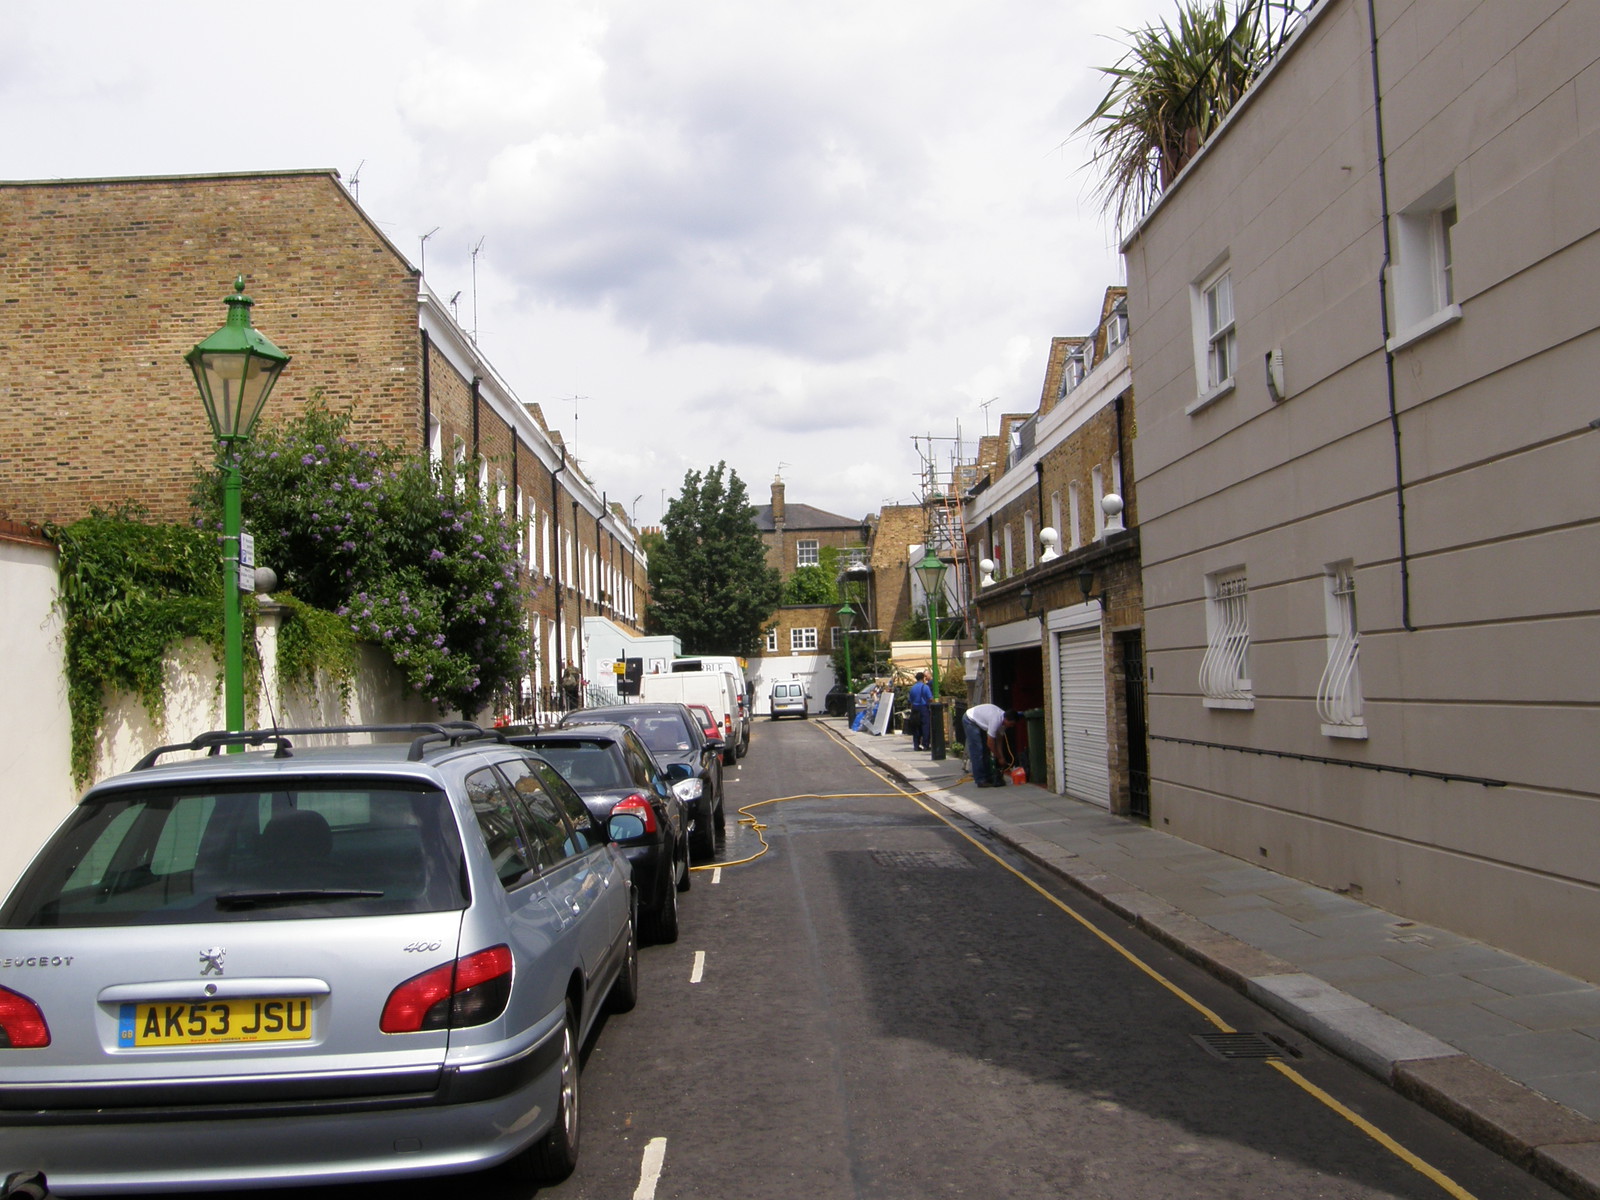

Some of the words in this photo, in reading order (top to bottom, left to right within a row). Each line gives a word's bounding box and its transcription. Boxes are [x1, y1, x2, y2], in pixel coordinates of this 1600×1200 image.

[0, 956, 74, 968] EUGEOT
[142, 1004, 229, 1037] AK53
[241, 1001, 306, 1033] JSU
[121, 1030, 133, 1039] GB
